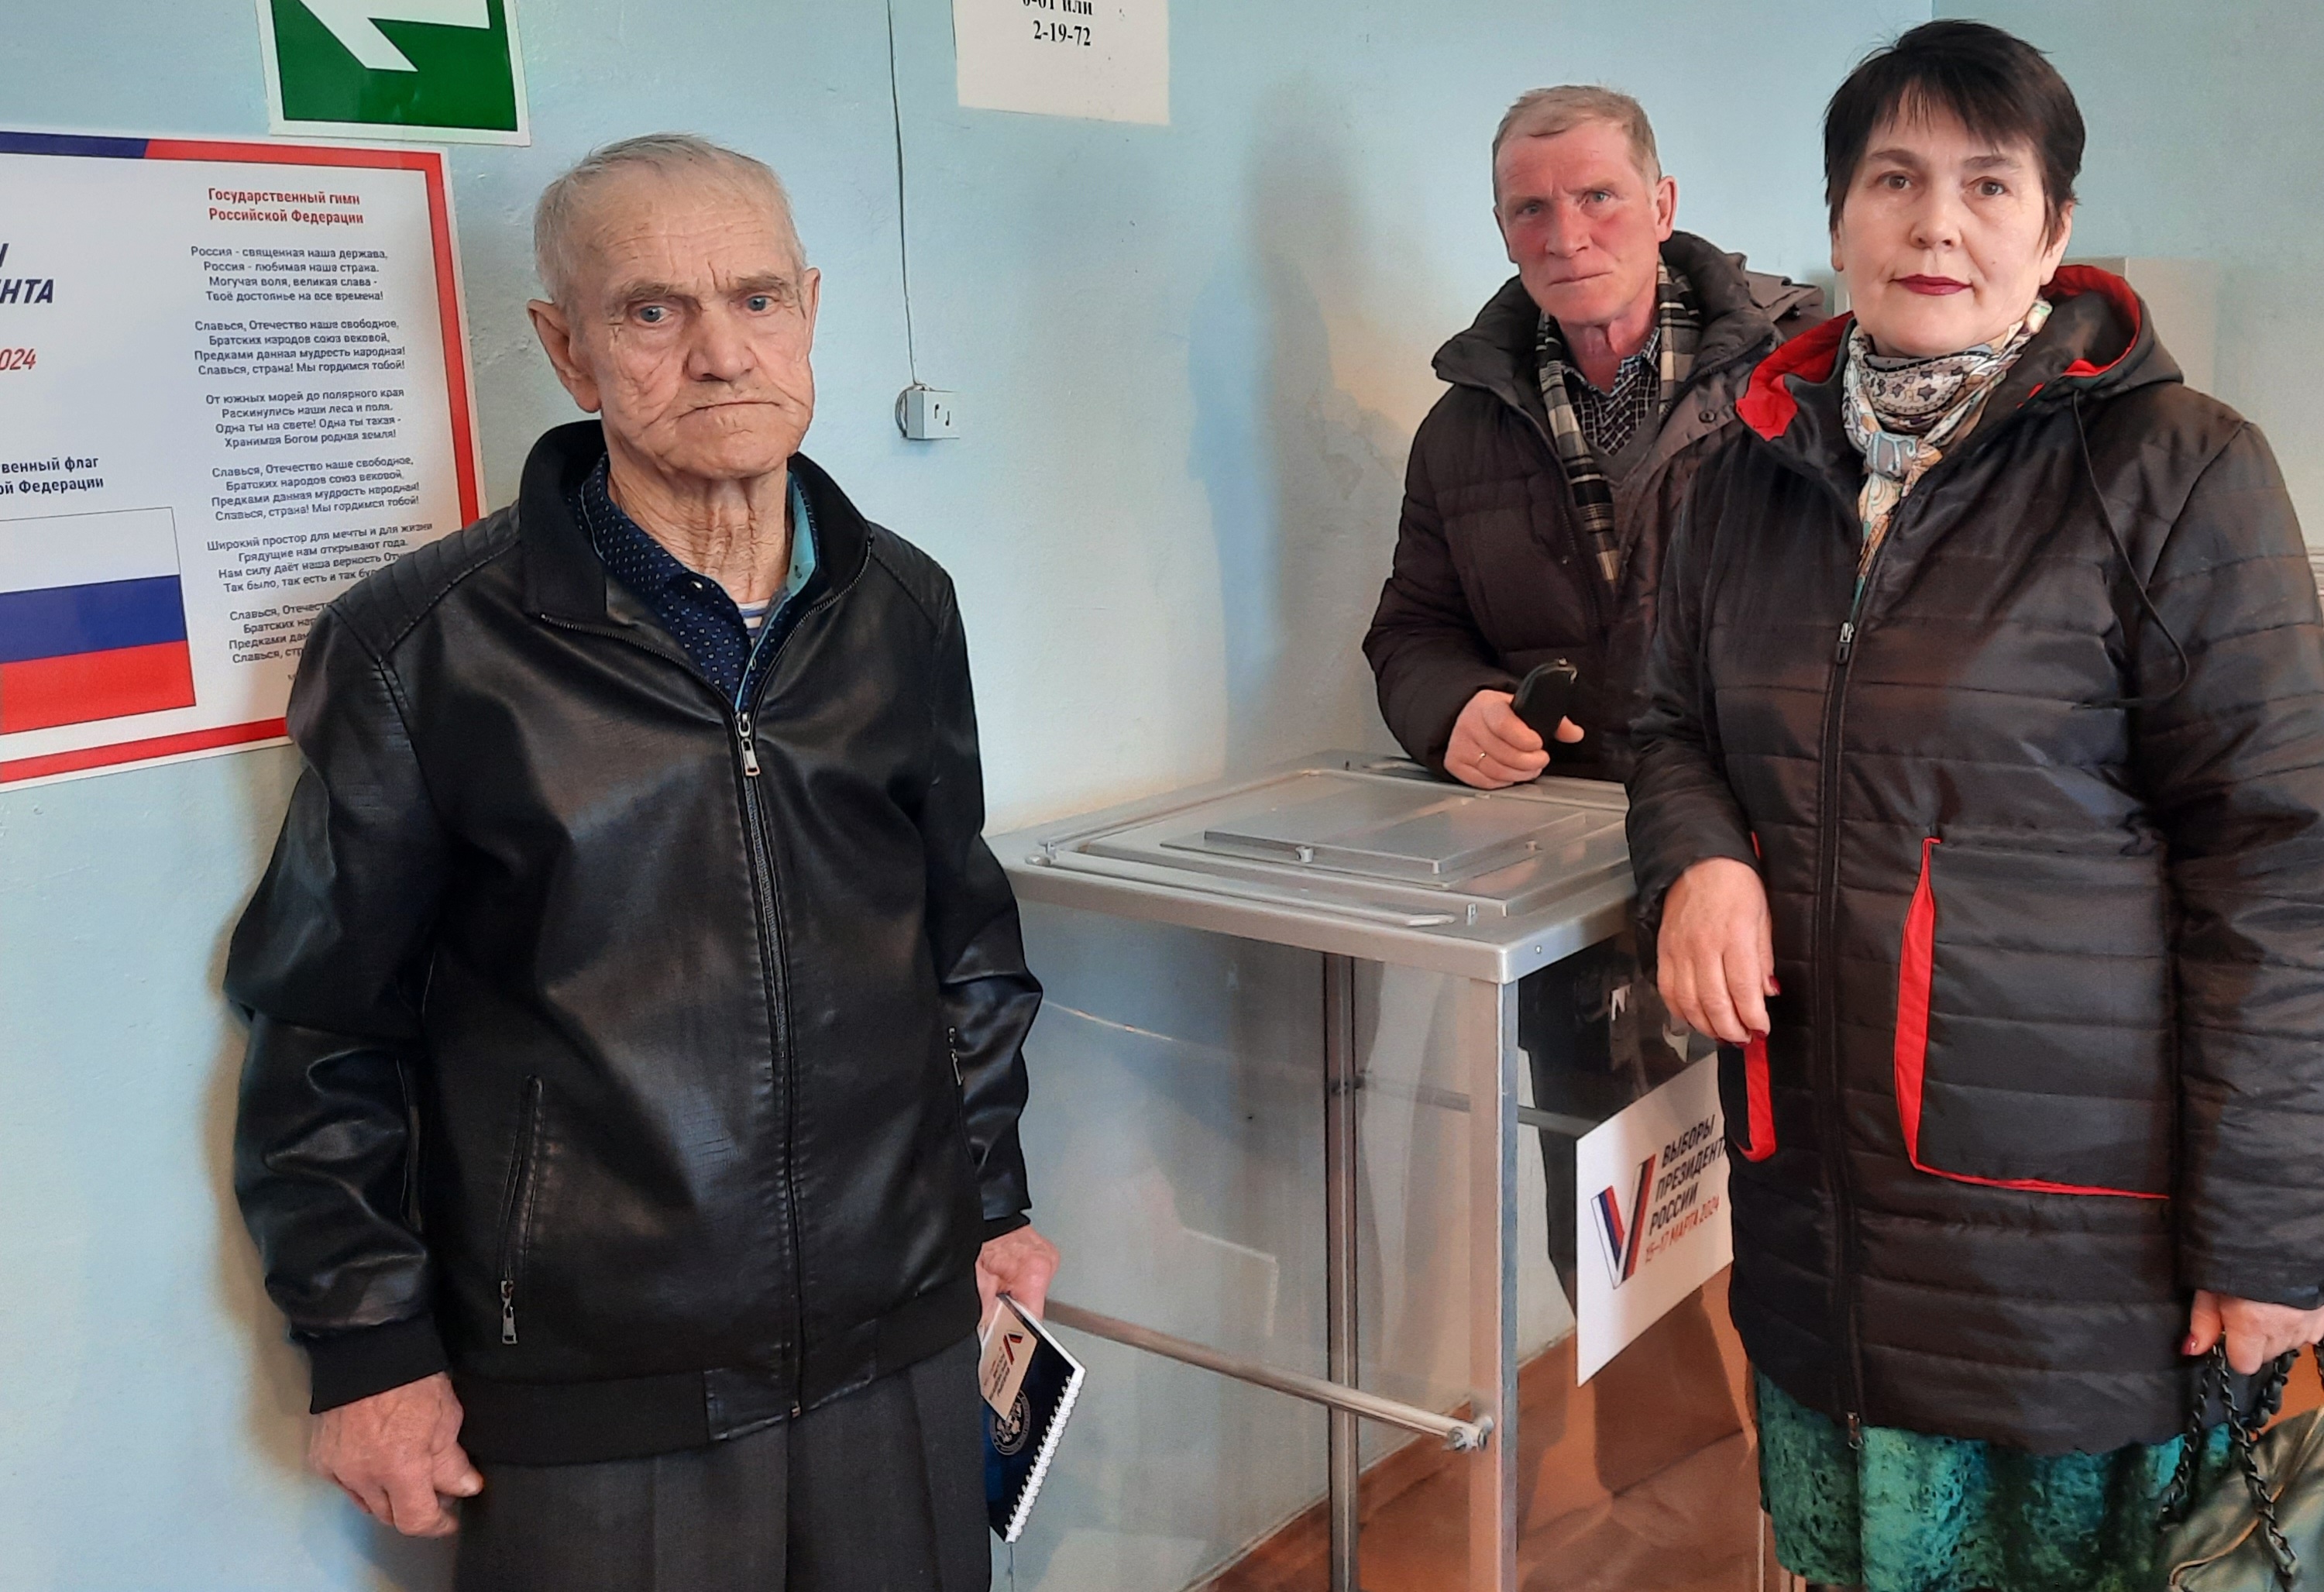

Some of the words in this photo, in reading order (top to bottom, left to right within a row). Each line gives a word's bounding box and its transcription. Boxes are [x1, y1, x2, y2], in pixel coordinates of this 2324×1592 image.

[1033, 19, 1091, 46] 2-19-72
[208, 187, 326, 205] Государственный
[329, 194, 359, 205] гимн
[209, 208, 287, 222] Российской
[291, 209, 363, 225] Федерации
[191, 246, 232, 256] Россия
[242, 248, 304, 258] священная
[308, 249, 336, 257] наша
[204, 261, 245, 271] Россия
[255, 263, 306, 271] любимая
[309, 263, 337, 272] наша
[209, 277, 257, 288] Могучая
[260, 278, 290, 287] воля,
[0, 279, 53, 304] НТА
[205, 291, 233, 301] Твоё
[335, 291, 383, 301] времена!
[194, 321, 246, 332] Славься,
[249, 320, 308, 330] Отечество
[209, 336, 262, 346] Братских
[265, 335, 311, 345] народов
[314, 334, 341, 343] союз
[194, 350, 253, 362] Предками
[256, 349, 297, 361] данная
[300, 349, 350, 359] мудрость
[353, 346, 405, 357] народная!
[198, 365, 249, 376] Славься,
[252, 363, 294, 375] страна!
[296, 362, 316, 372] Мы
[318, 362, 369, 373] гордимся
[371, 360, 405, 370] тобой!
[205, 394, 220, 404] От
[223, 394, 266, 404] южных
[268, 391, 304, 403] морей
[306, 393, 321, 402] до
[322, 390, 377, 400] полярного
[380, 389, 404, 398] края
[222, 408, 295, 420] Раскинулись
[328, 405, 353, 414] леса
[215, 423, 245, 435] Одна
[249, 423, 263, 432] ты
[283, 420, 316, 430] свете!
[318, 418, 346, 428] Одна
[366, 417, 395, 425] такая
[225, 437, 281, 449] Хранимая
[284, 435, 318, 445] Богом
[321, 432, 359, 443] родная
[64, 456, 99, 473] флаг
[212, 466, 263, 478] Славься,
[266, 463, 323, 474] Отечество
[326, 460, 353, 469] наше
[19, 478, 105, 495] Федерации
[225, 479, 279, 493] Братских
[281, 476, 326, 487] народов
[329, 474, 356, 483] союз
[211, 495, 270, 507] Предками
[273, 491, 312, 504] данная
[315, 487, 366, 500] мудрость
[369, 482, 419, 495] народная!
[215, 509, 266, 521] Славься,
[268, 504, 309, 518] страна!
[311, 504, 332, 513] Мы
[334, 500, 384, 512] гордимся
[387, 496, 419, 507] тобой!
[207, 537, 260, 551] Широкий
[263, 533, 307, 546] простор
[310, 531, 330, 542] для
[333, 529, 367, 539] мечты
[378, 525, 398, 537] для
[238, 548, 294, 563] Грядущие
[296, 547, 317, 557] нам
[320, 540, 380, 556] открывают
[218, 568, 242, 579] Нам
[246, 566, 271, 578] силу
[273, 562, 300, 575] даёт
[302, 562, 330, 572] наша
[333, 555, 381, 567] верность
[224, 583, 243, 593] Так
[247, 579, 279, 590] было,
[282, 579, 300, 587] так
[304, 574, 327, 583] есть
[339, 570, 356, 579] так
[230, 608, 280, 621] Славься,
[243, 621, 294, 634] Братских
[229, 637, 287, 649] Предками
[233, 650, 283, 663] Славься,
[1662, 1114, 1716, 1168] ВЫБОРЫ
[1649, 1181, 1699, 1236] РОССИИ
[1669, 1209, 1699, 1246] МАРТА
